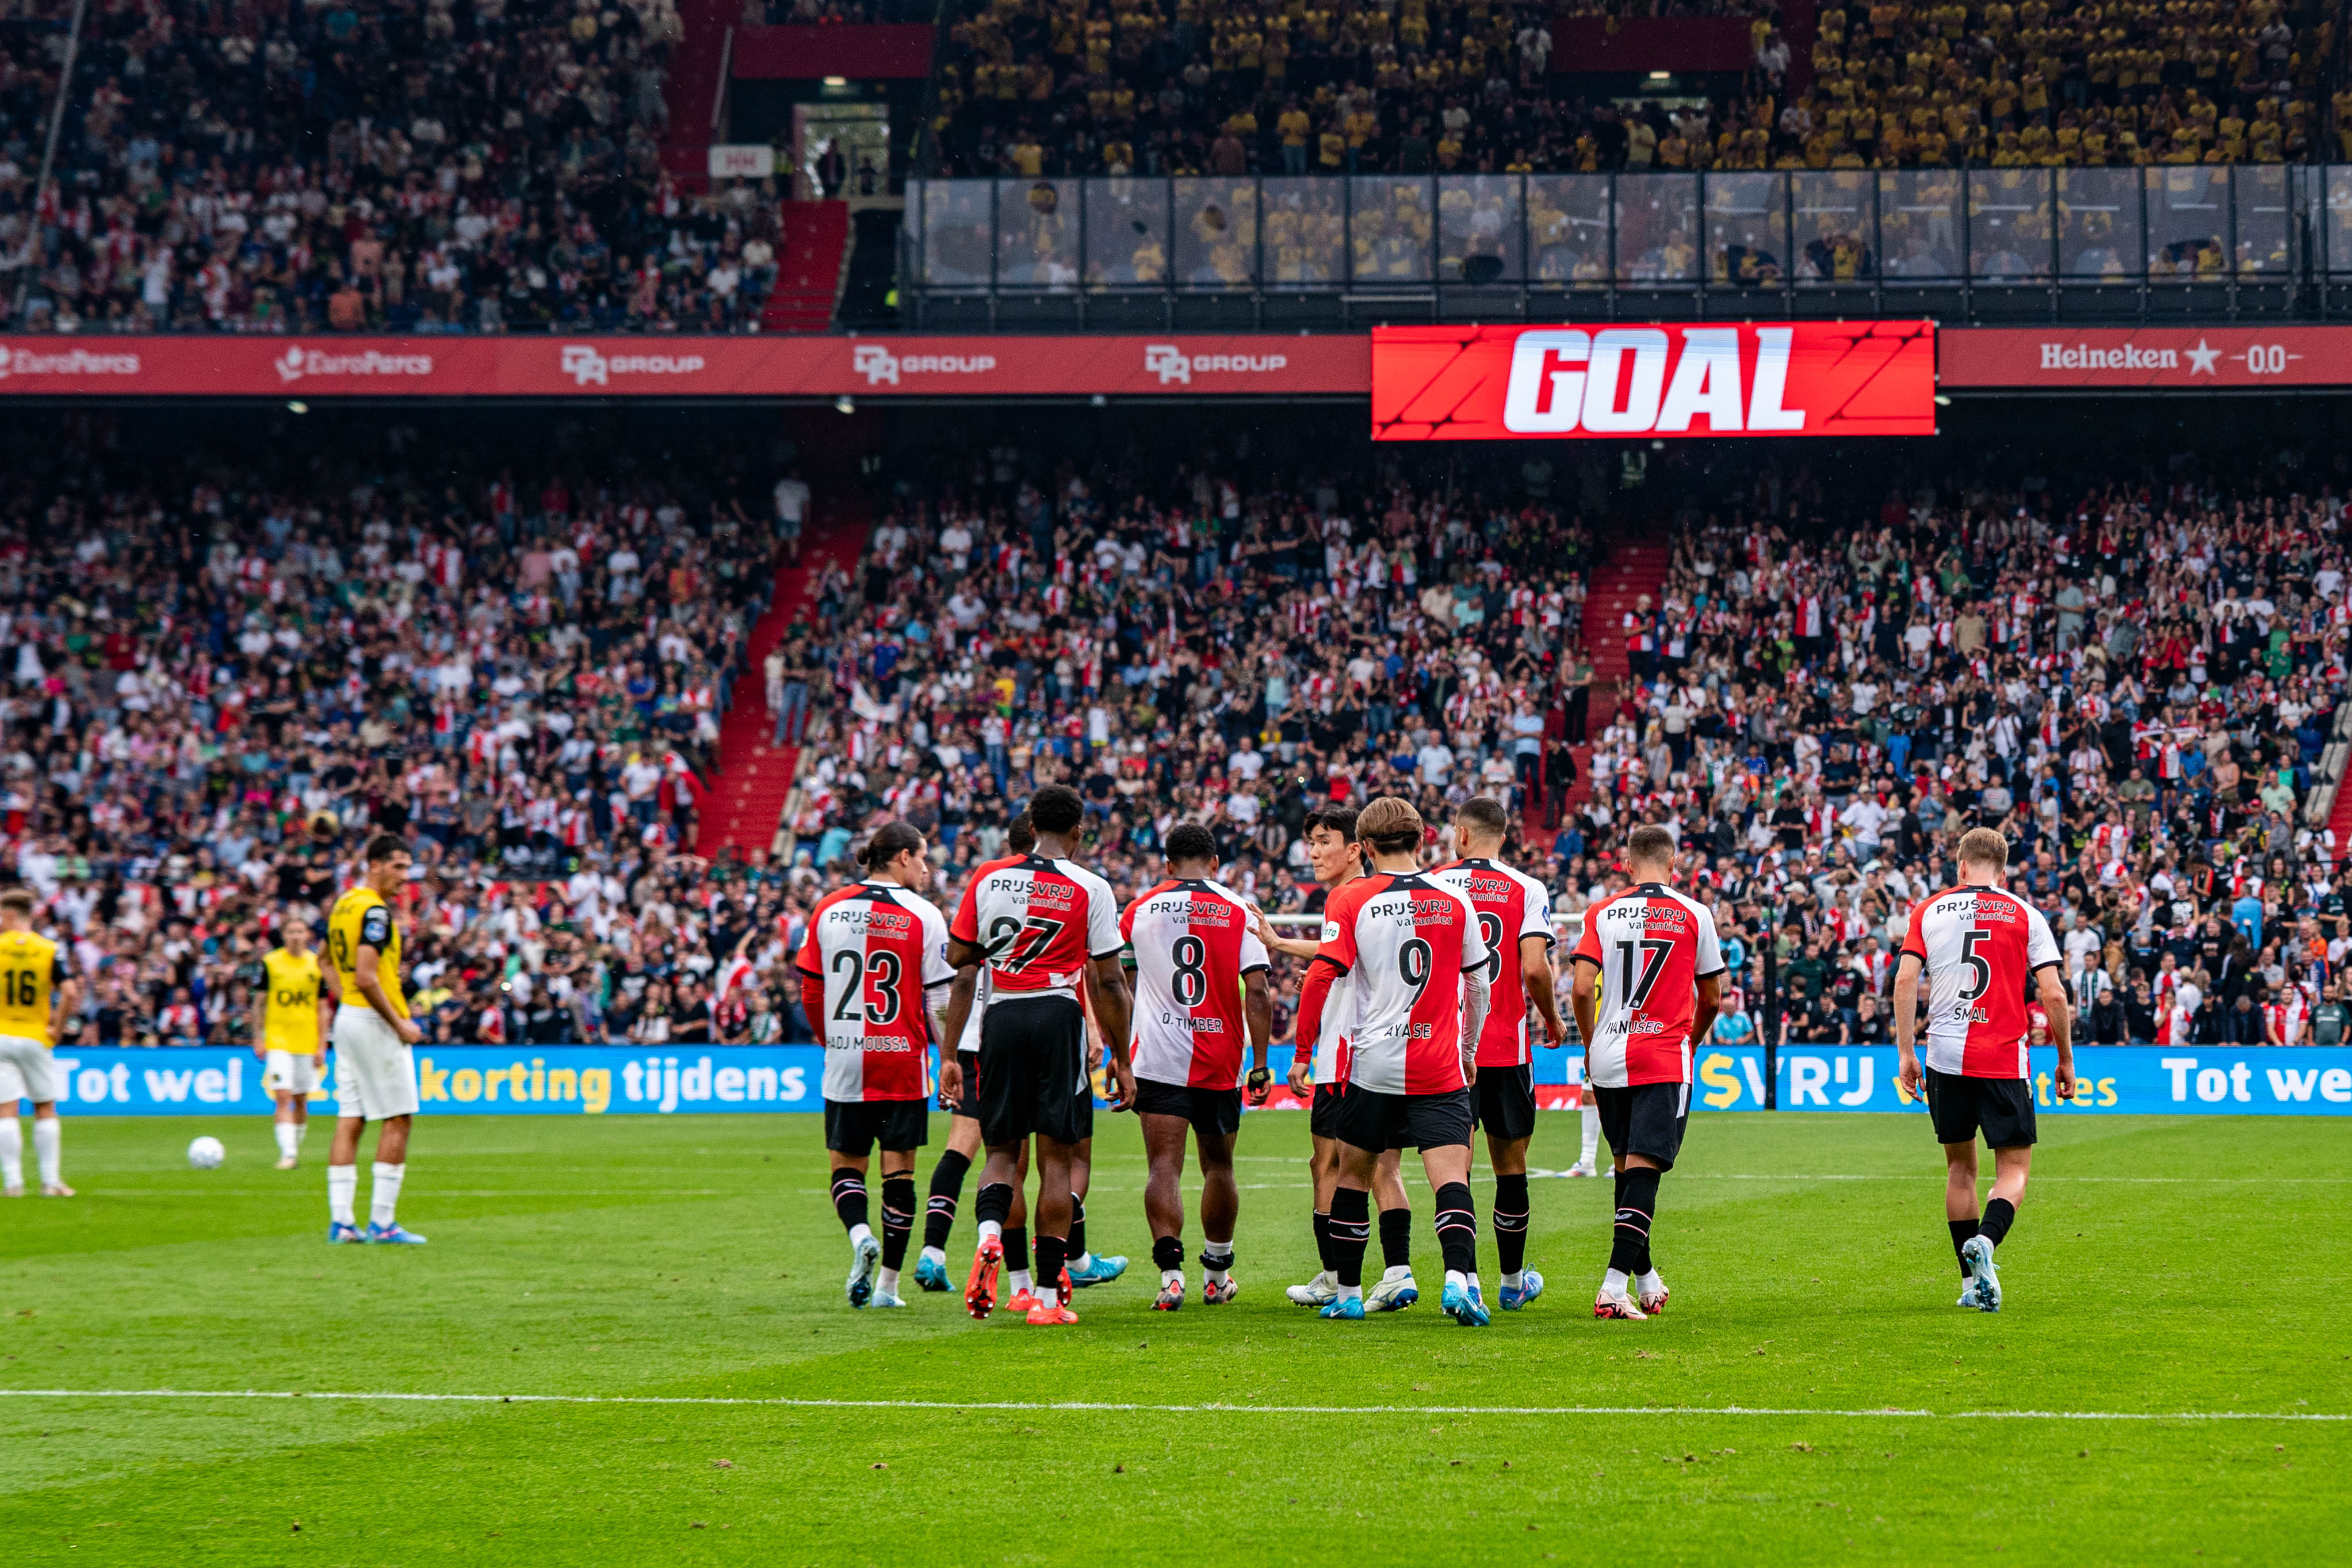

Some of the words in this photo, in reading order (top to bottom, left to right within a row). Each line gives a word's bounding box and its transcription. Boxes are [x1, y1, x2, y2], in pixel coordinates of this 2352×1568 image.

[610, 355, 704, 373] GROUP
[901, 355, 996, 373] GROUP
[1193, 354, 1287, 372] GROUP
[2040, 343, 2179, 369] Heineken
[1503, 327, 1806, 433] GOAL
[1012, 896, 1072, 912] vakanties
[1172, 914, 1230, 927] vakanties
[1396, 913, 1454, 927] vakanties
[1959, 911, 2016, 924] vakanties
[1628, 920, 1685, 934] vakanties
[989, 915, 1065, 974] 27
[1172, 935, 1206, 1007] 8
[1958, 929, 1991, 1000] 5
[1398, 937, 1433, 1013] 9
[1616, 938, 1676, 1011] 17
[5, 969, 36, 1006] 16
[832, 949, 902, 1025] 23
[1953, 1007, 1989, 1023] SMAL
[1175, 1016, 1224, 1034] TIMBER
[1384, 1023, 1432, 1039] AYASE
[854, 1036, 911, 1052] MOUSSA
[56, 1058, 130, 1103] Tot
[144, 1058, 242, 1103] wel
[420, 1058, 611, 1114] korting
[622, 1057, 806, 1113] tijdens
[2161, 1058, 2251, 1103] Tot
